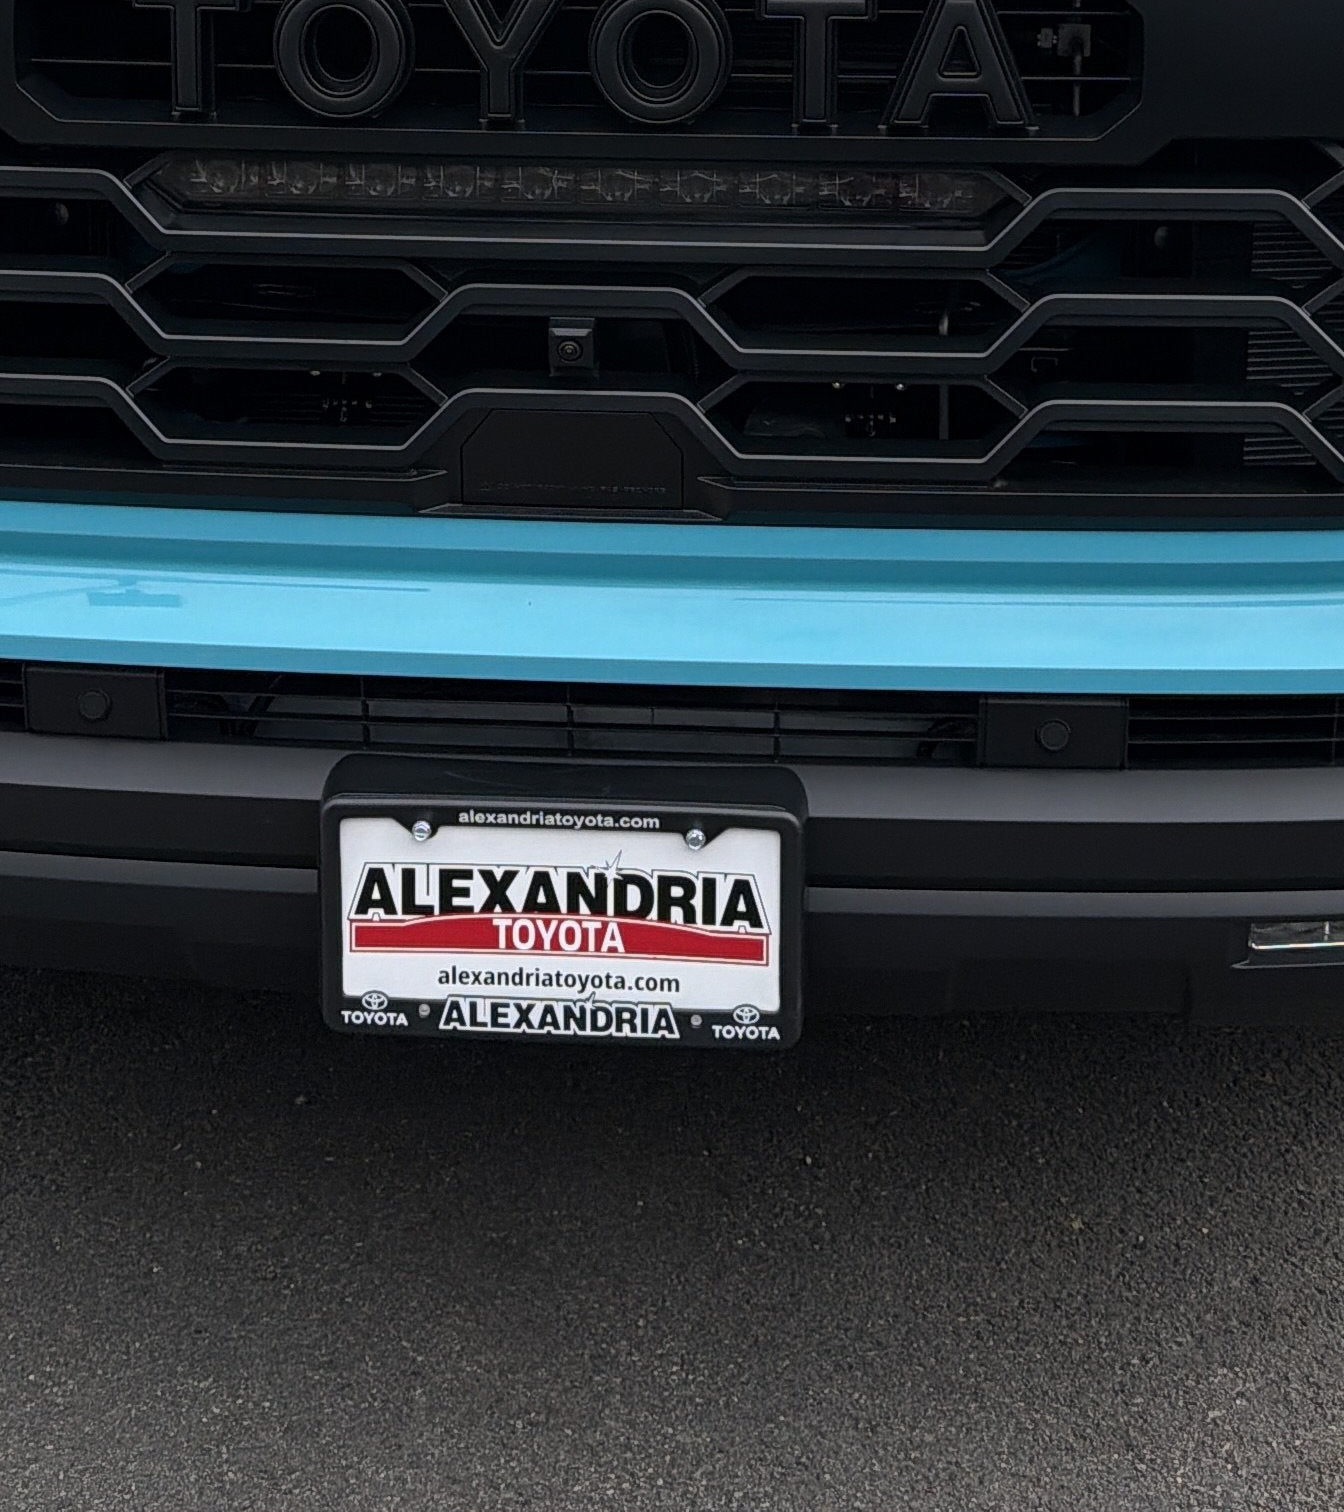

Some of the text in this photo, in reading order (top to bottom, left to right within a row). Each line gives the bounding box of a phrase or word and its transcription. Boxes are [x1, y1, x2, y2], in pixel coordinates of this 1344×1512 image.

[458, 810, 661, 831] alexandriatoyota.com
[352, 865, 767, 931] ALEXANDRIA
[492, 918, 626, 954] TOYOTA
[437, 965, 681, 994] alexandriatoyota.com
[341, 1010, 409, 1028] TOYOTA
[439, 995, 680, 1039] ALEXANDRIA
[711, 1024, 781, 1041] TOYOTA
